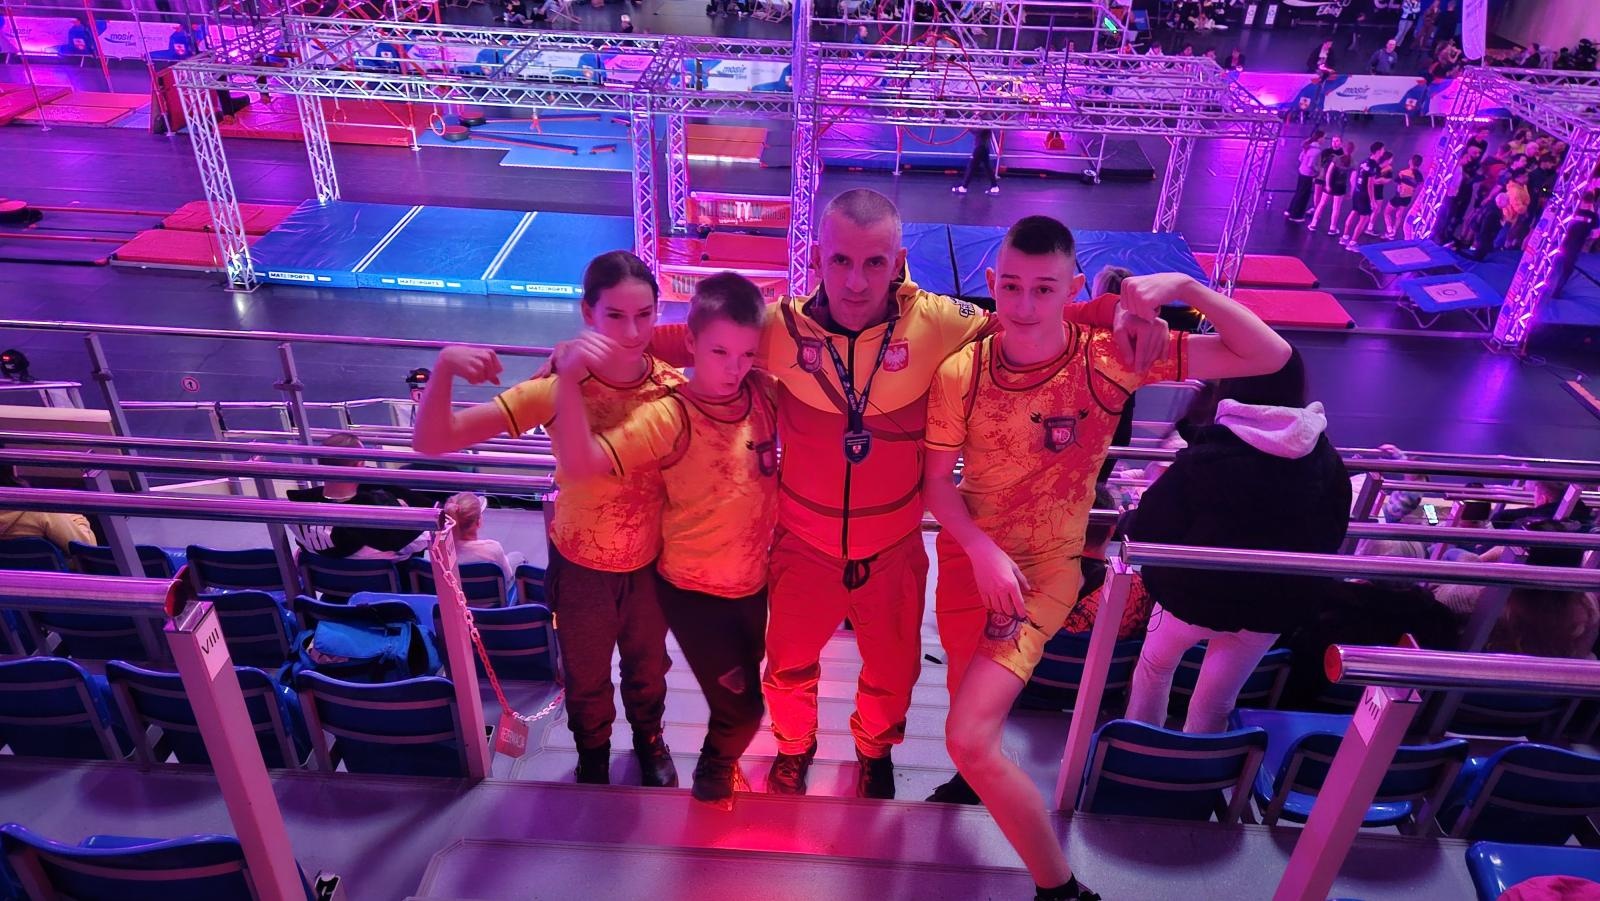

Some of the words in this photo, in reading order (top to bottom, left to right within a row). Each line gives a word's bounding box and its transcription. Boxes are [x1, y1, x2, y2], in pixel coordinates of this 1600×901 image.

[110, 32, 135, 41] mosir
[201, 628, 220, 655] VIII
[1364, 689, 1380, 720] VIII
